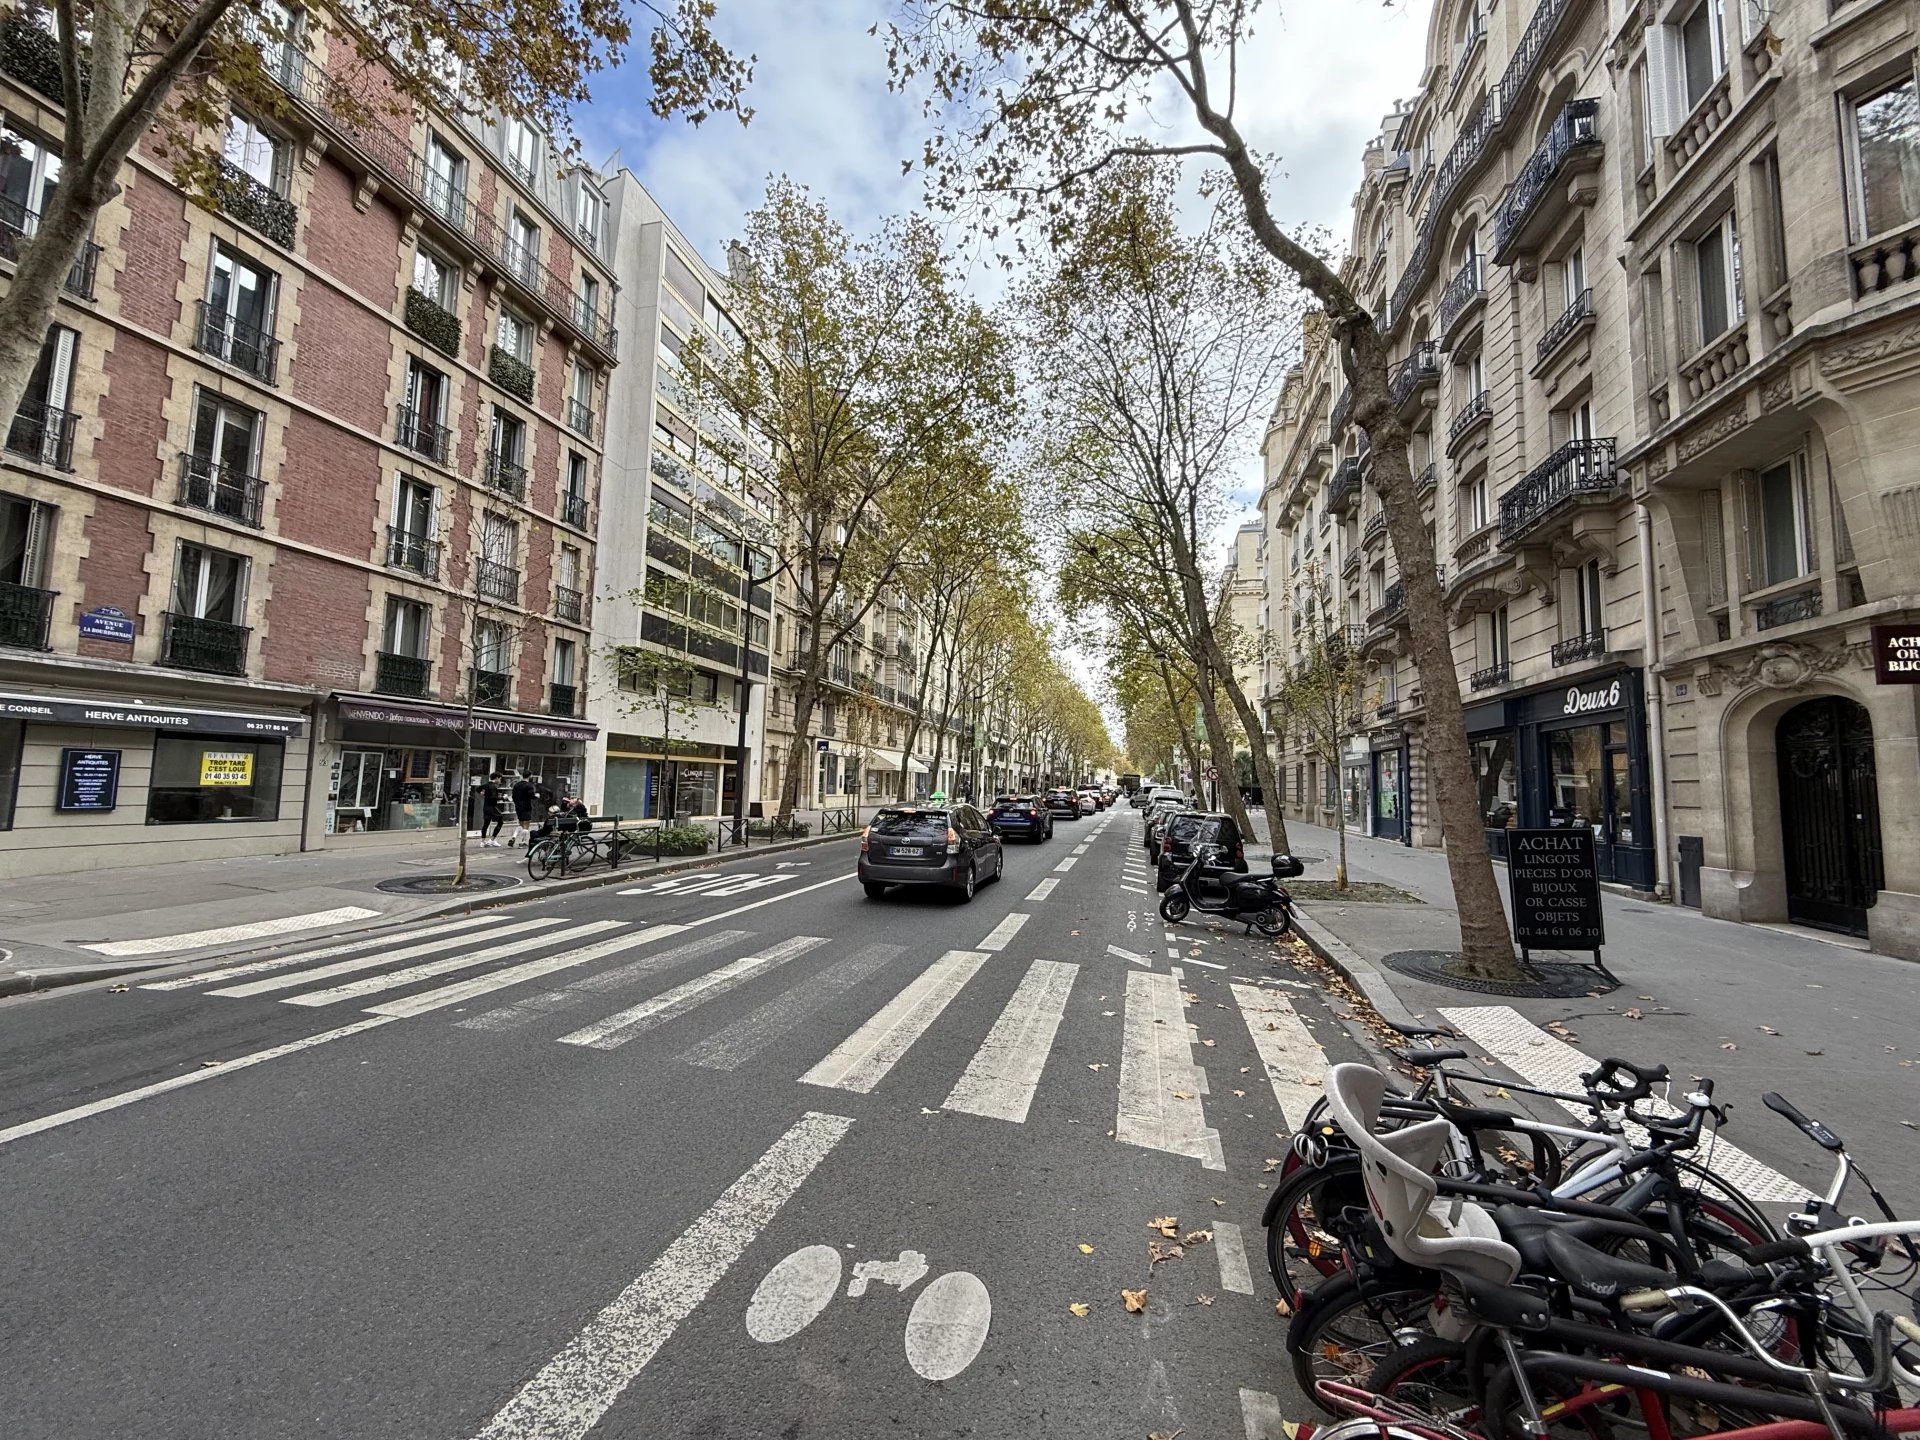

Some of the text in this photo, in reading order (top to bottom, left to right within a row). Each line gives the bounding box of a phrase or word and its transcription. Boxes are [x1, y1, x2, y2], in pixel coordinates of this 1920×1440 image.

[94, 619, 124, 628] AVENUE
[91, 627, 132, 638] BOURDONNAIS
[1888, 636, 1920, 648] ACH
[1896, 648, 1920, 659] OR
[8, 705, 54, 715] CONSEIL
[85, 710, 125, 721] HERVE
[204, 772, 212, 780] 01
[214, 772, 221, 780] 40
[1518, 836, 1583, 850] ACHAT
[1524, 854, 1580, 864] LINGOTS
[1515, 868, 1593, 878] PIECES D'OR
[1532, 883, 1577, 894] BIJOUX
[1525, 897, 1588, 907] OR CASSE
[1535, 911, 1580, 923] OBJETS
[1518, 927, 1599, 936] 01 44 61 06 10
